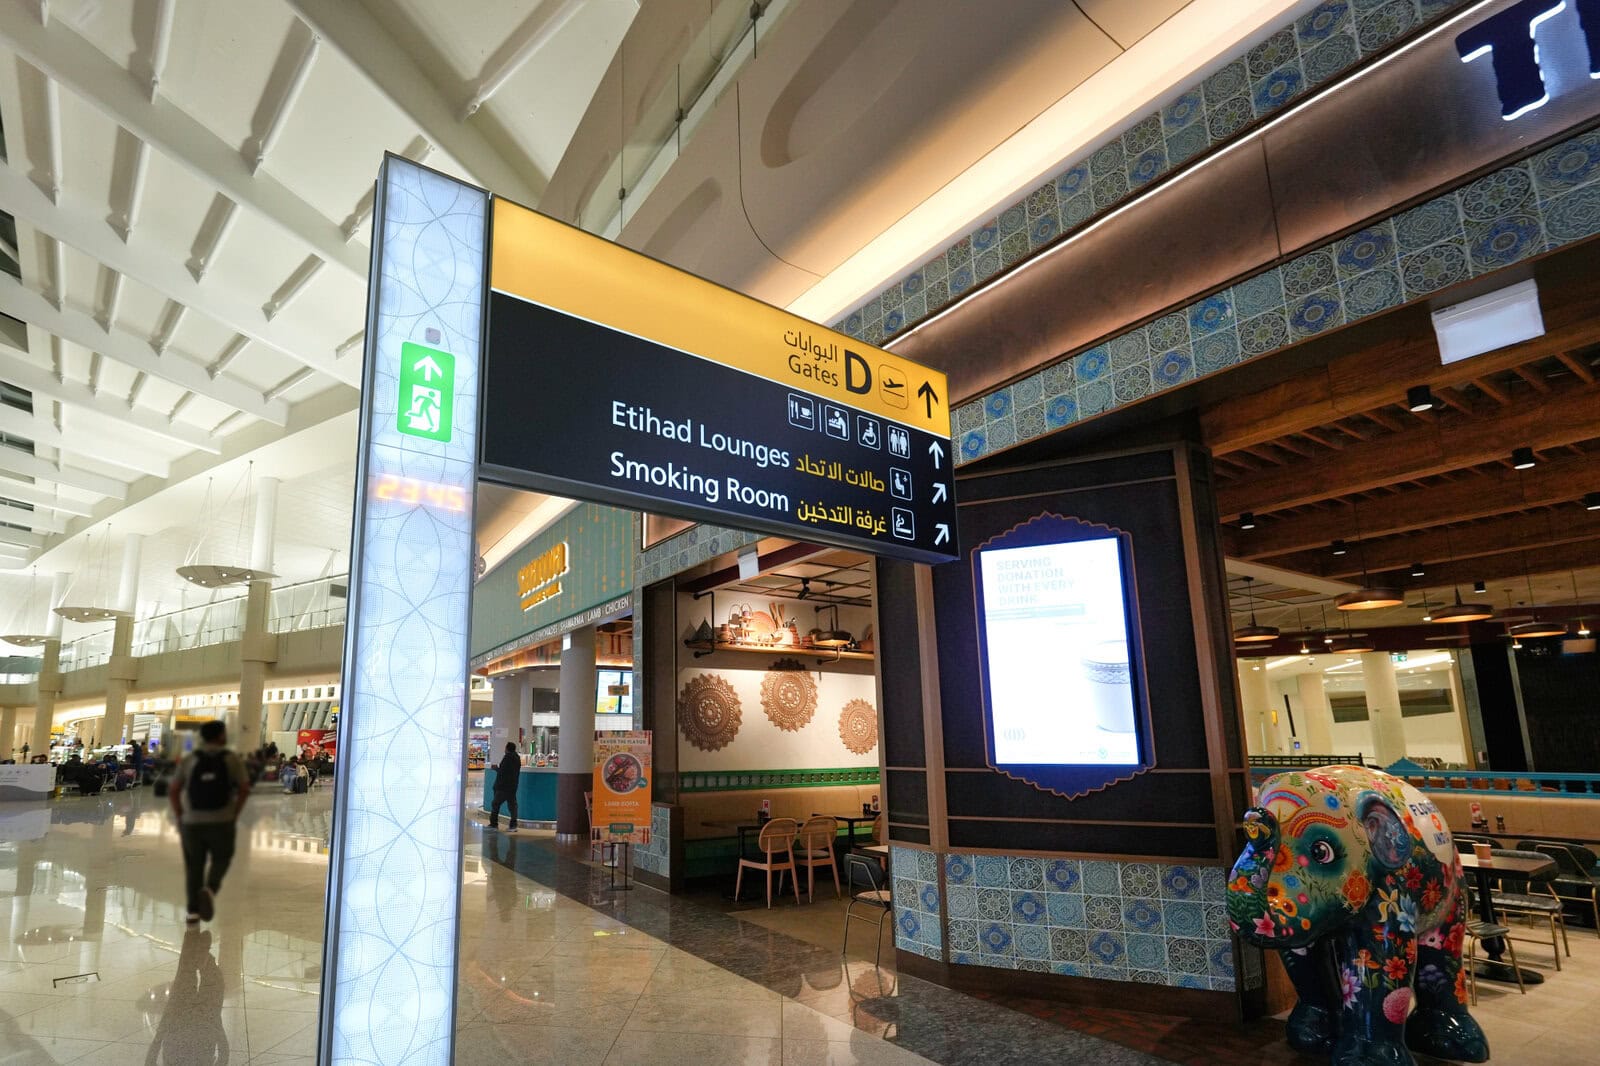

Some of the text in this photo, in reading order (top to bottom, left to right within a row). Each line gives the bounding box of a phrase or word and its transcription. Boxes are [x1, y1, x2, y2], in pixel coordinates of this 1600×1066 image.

[1455, 0, 1600, 121] T
[783, 329, 838, 362] البوابات
[788, 348, 872, 395] Gates D
[611, 400, 790, 468] Etihad Lounges
[610, 451, 789, 512] Smoking Room
[795, 454, 885, 493] صالات الاتحاد
[797, 500, 887, 536] غرفة التدخين
[996, 556, 1052, 571] SERVING
[997, 567, 1064, 583] DONATION
[998, 578, 1074, 595] WITH EVERY
[587, 609, 602, 621] LAMB
[605, 597, 629, 615] CHICKEN
